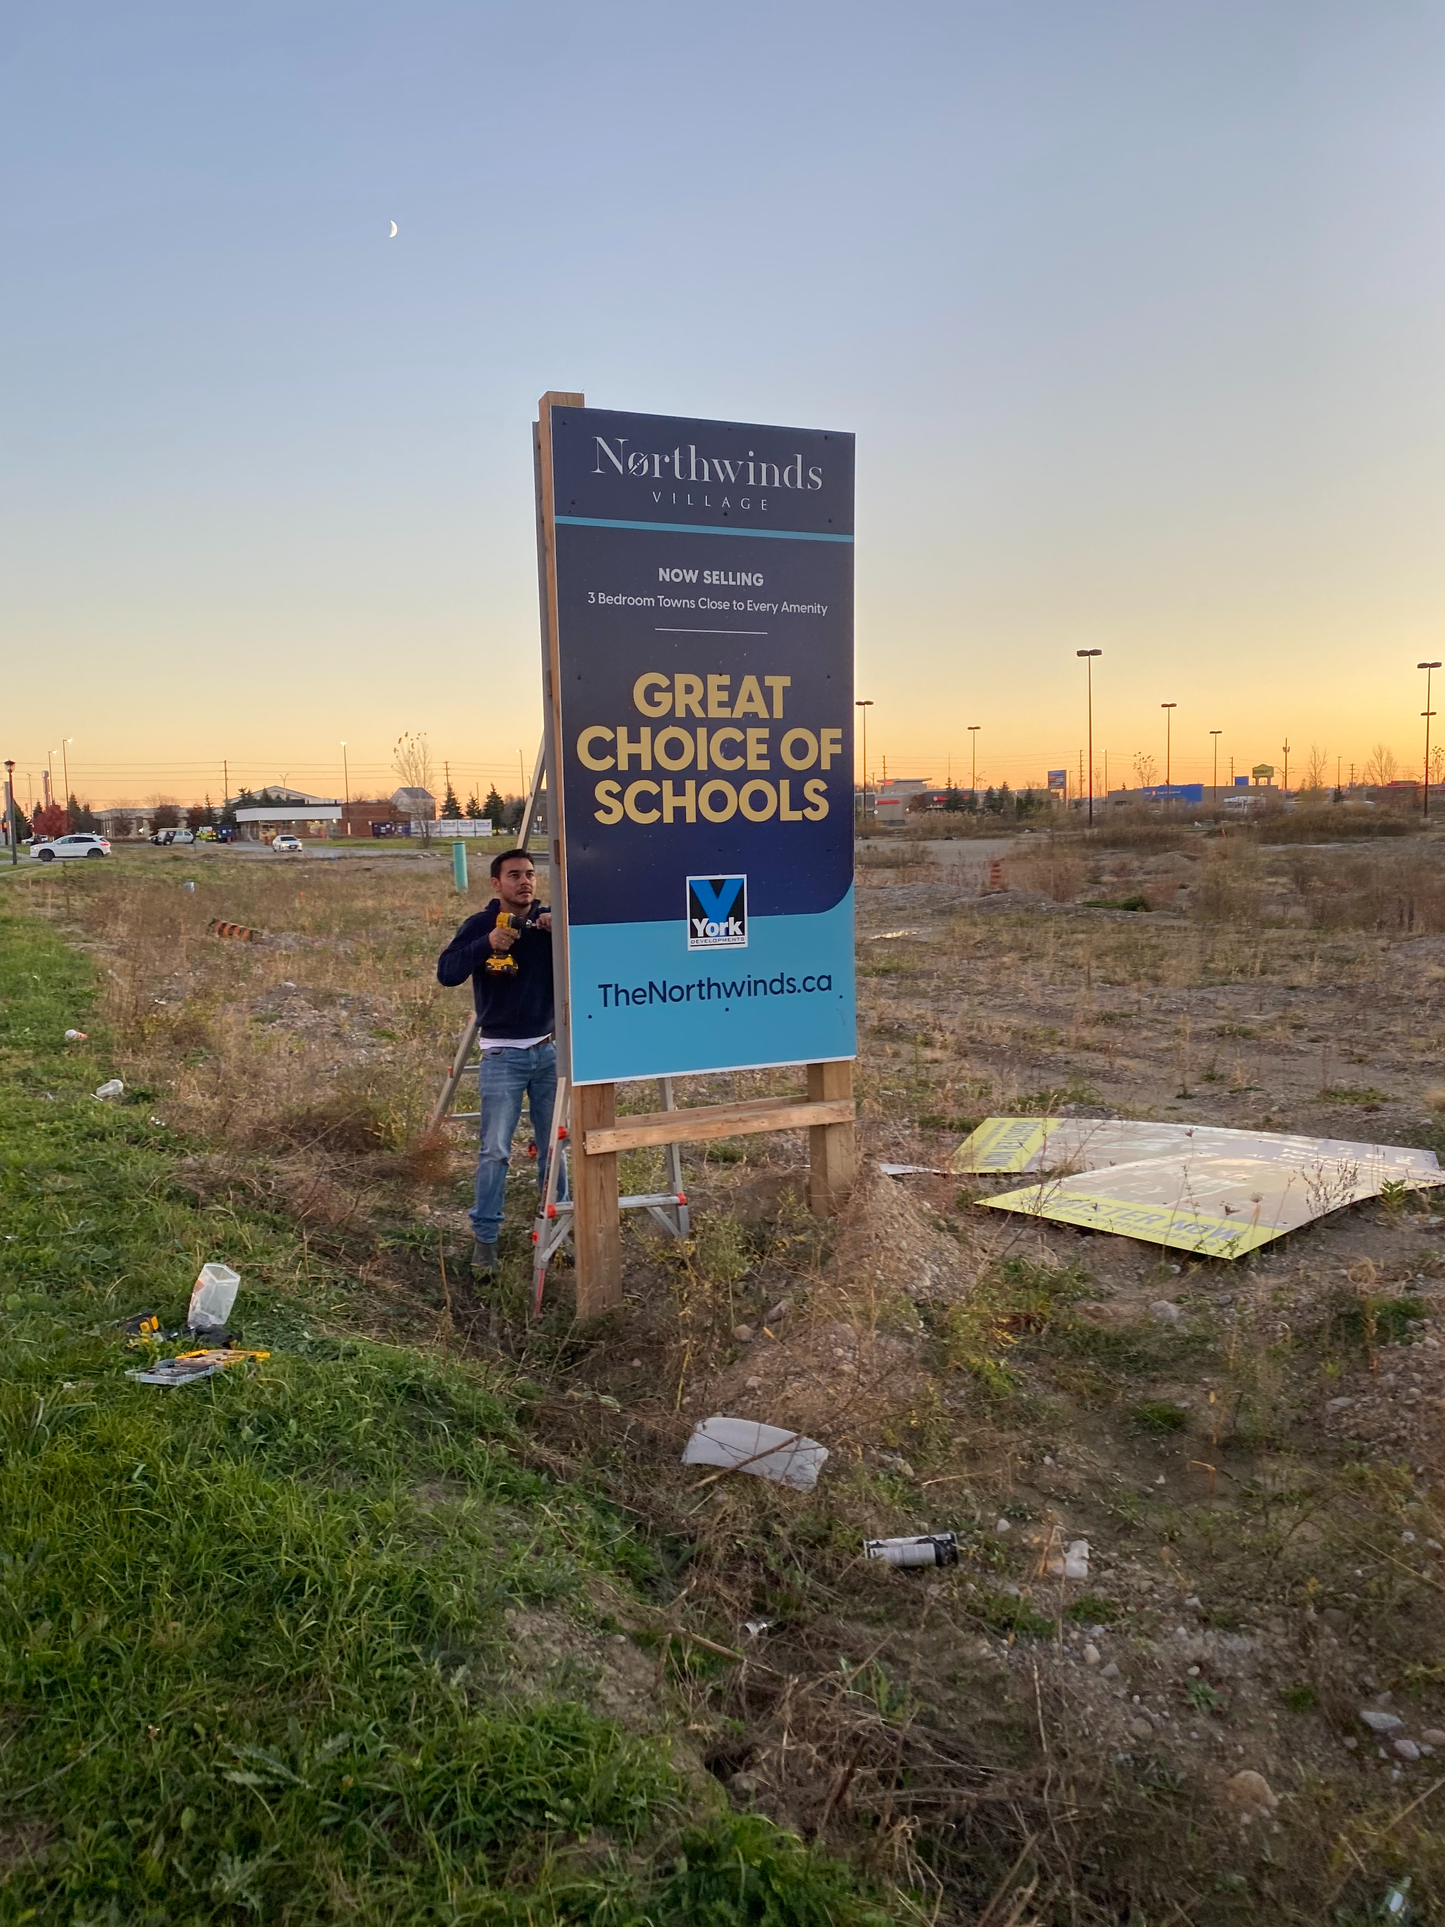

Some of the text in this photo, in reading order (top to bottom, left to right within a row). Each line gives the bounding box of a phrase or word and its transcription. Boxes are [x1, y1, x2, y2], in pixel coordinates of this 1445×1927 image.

[652, 491, 768, 511] VILLAGE
[658, 567, 764, 587] NOW SELLING
[587, 591, 828, 616] 3 Bedroom Towns Close to Every Amenity
[633, 672, 791, 719] GREAT
[576, 725, 842, 771] CHOICE OF
[594, 778, 830, 825] SCHOOLS
[691, 916, 743, 937] York
[598, 972, 833, 1008] TheNorthwinds.ca
